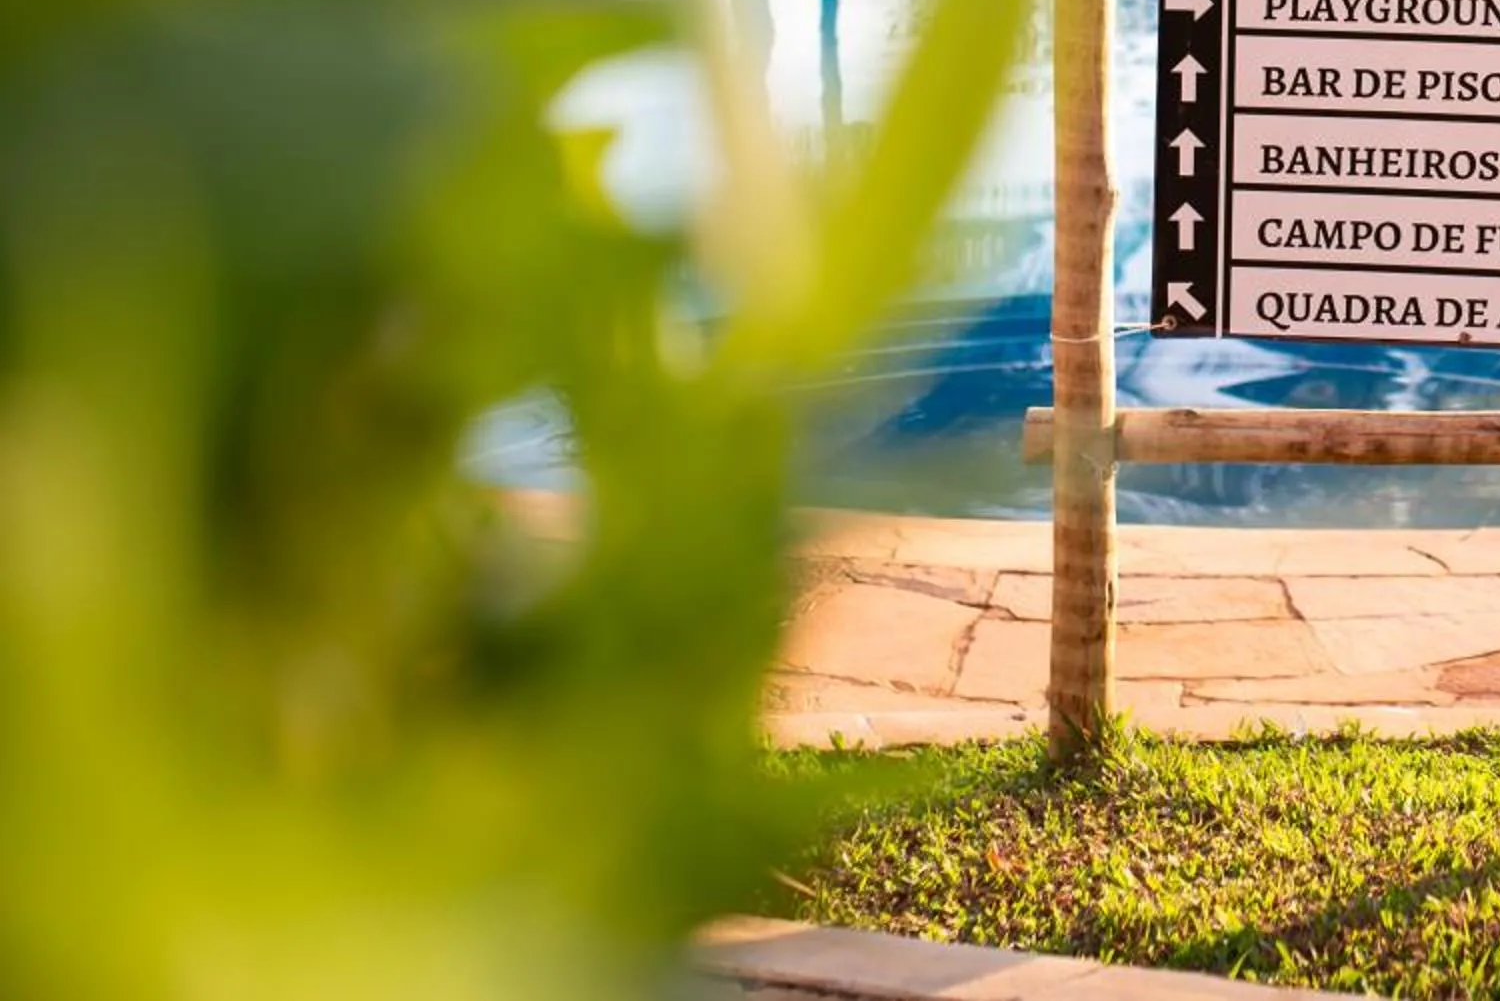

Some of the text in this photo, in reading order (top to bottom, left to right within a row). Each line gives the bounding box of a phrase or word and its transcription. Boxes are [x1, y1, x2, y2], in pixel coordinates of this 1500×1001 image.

[1262, 66, 1343, 98] BAR
[1352, 69, 1407, 99] DE
[1260, 144, 1500, 181] BANHEIROS
[1257, 218, 1402, 252] CAMPO
[1412, 222, 1465, 254] DE
[1256, 292, 1426, 331] QUADRA
[1435, 297, 1489, 328] DE
